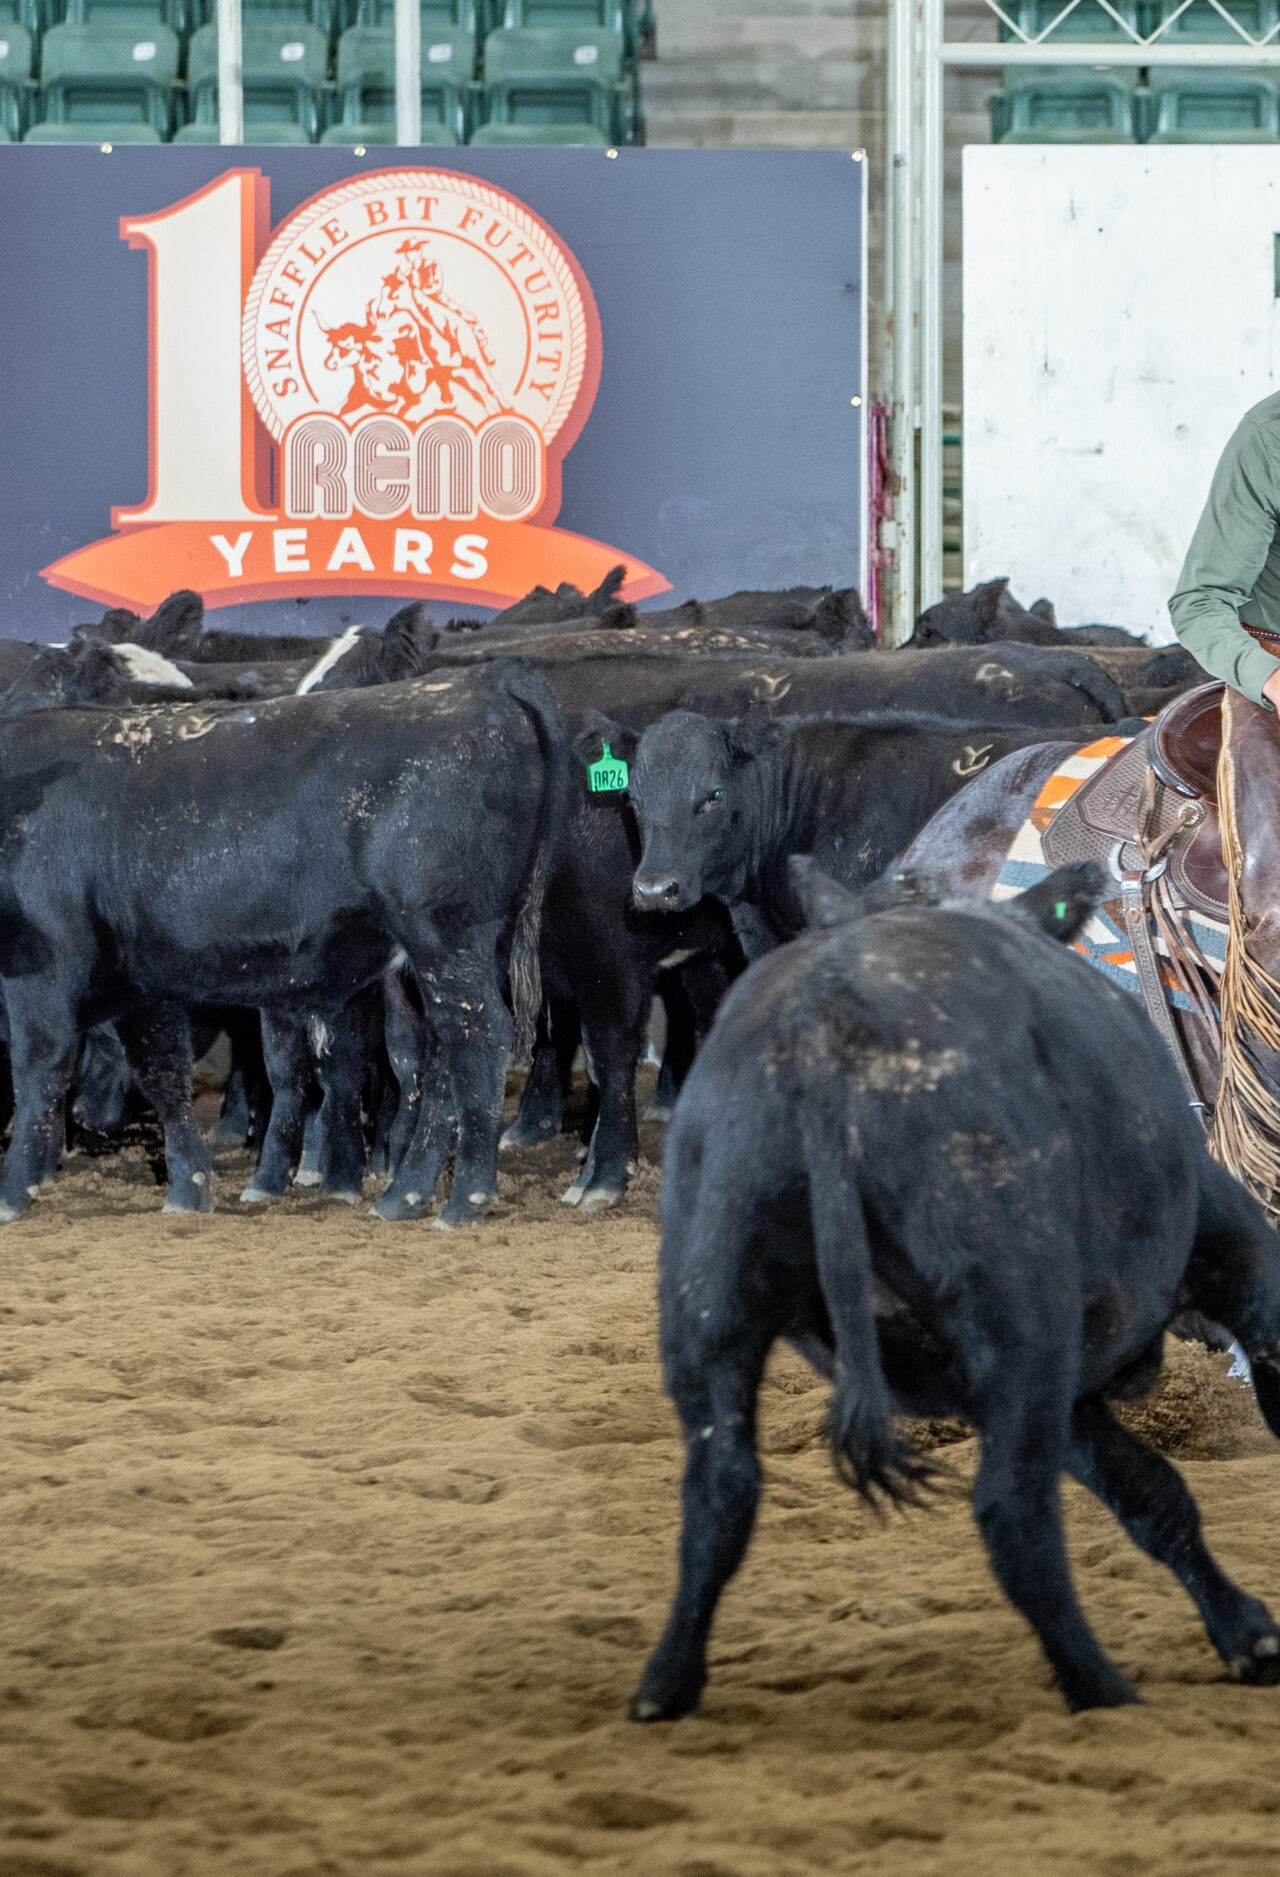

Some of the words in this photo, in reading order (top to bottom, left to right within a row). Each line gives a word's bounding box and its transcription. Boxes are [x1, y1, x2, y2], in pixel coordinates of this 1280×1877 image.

[265, 217, 349, 398] SNAFFLE
[364, 196, 439, 227] BIT
[457, 206, 563, 402] FUTURITY
[288, 416, 541, 519] RENO
[210, 527, 489, 580] YEARS
